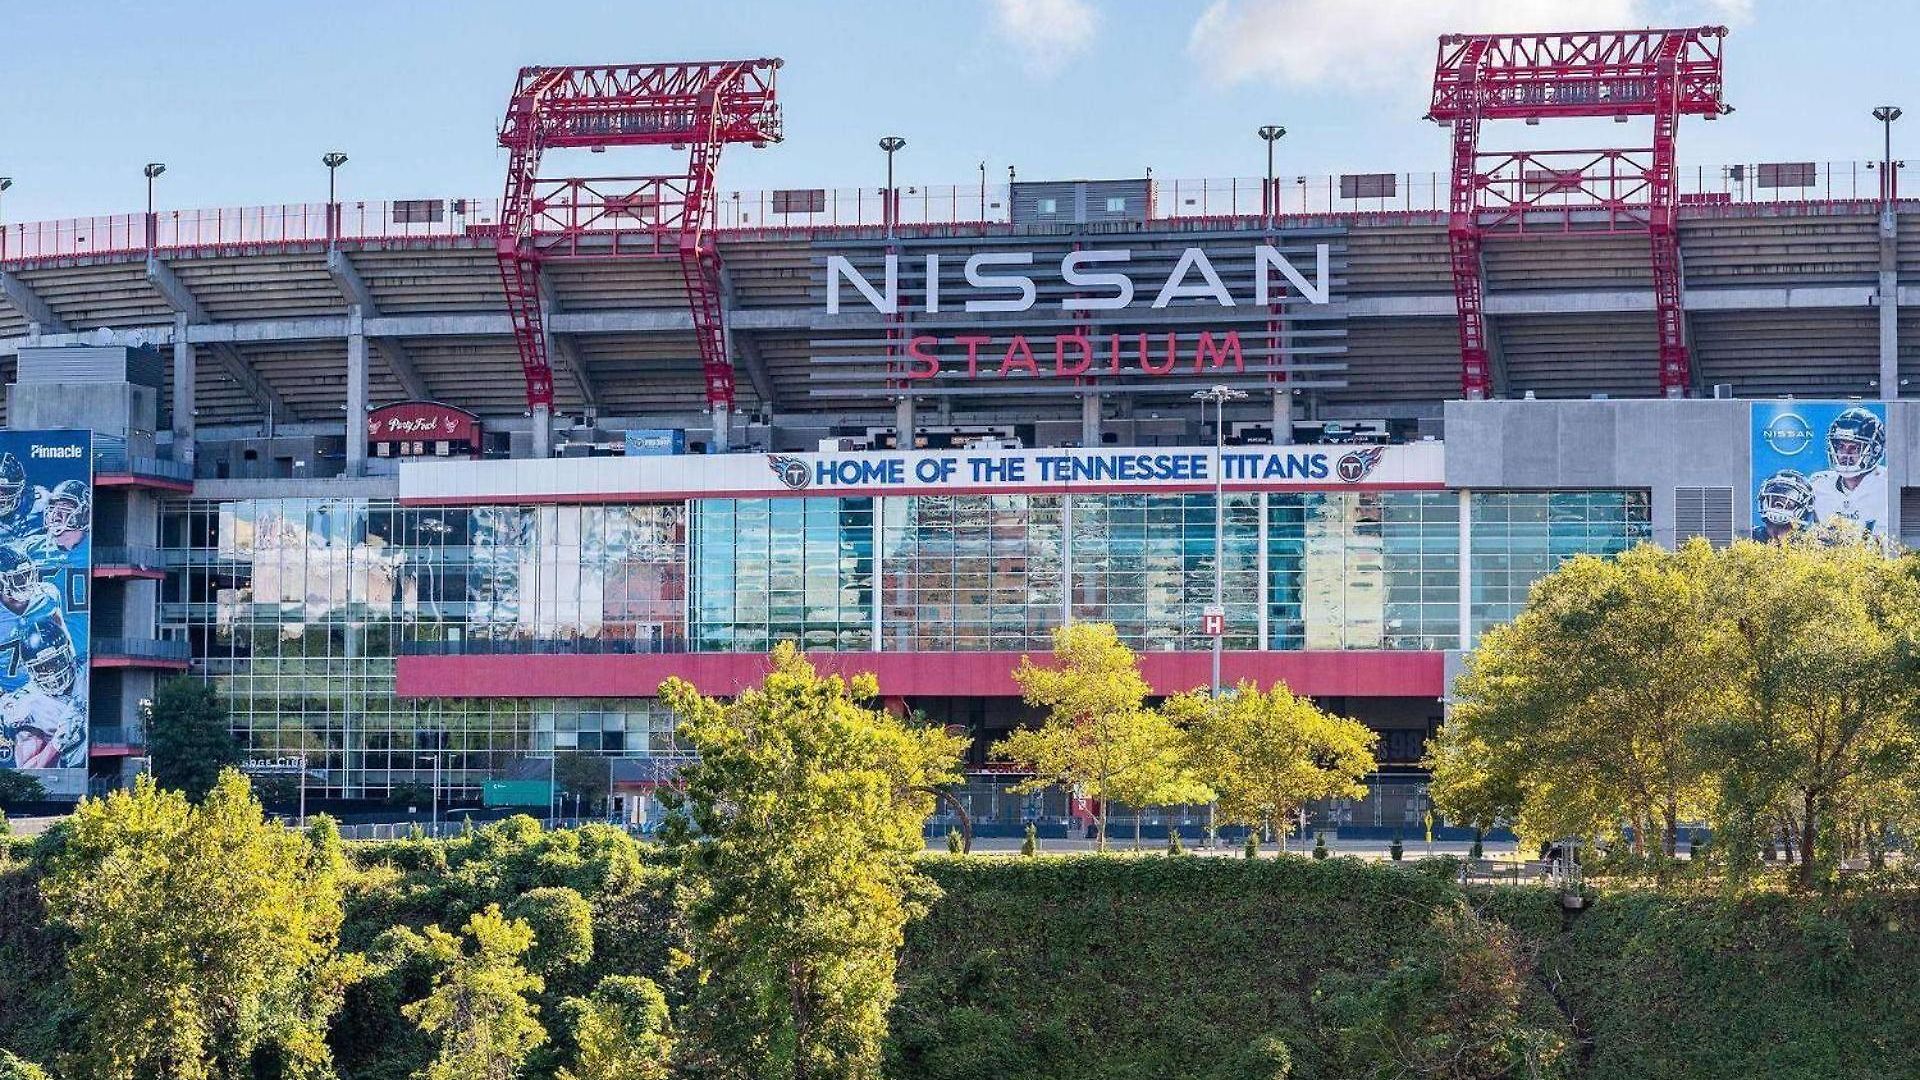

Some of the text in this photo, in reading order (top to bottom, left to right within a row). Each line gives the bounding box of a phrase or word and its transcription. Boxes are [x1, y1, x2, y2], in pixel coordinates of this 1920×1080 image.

[826, 244, 1330, 315] NISSAN
[906, 331, 1244, 379] STADIUM
[1763, 430, 1814, 438] NISSAN
[31, 444, 83, 459] Pinnacle
[816, 459, 905, 485] HOME
[916, 457, 957, 484] OF
[967, 456, 1025, 482] THE
[1036, 455, 1208, 481] TENNESSEE
[1221, 454, 1329, 479] TITANS
[1206, 616, 1221, 634] H
